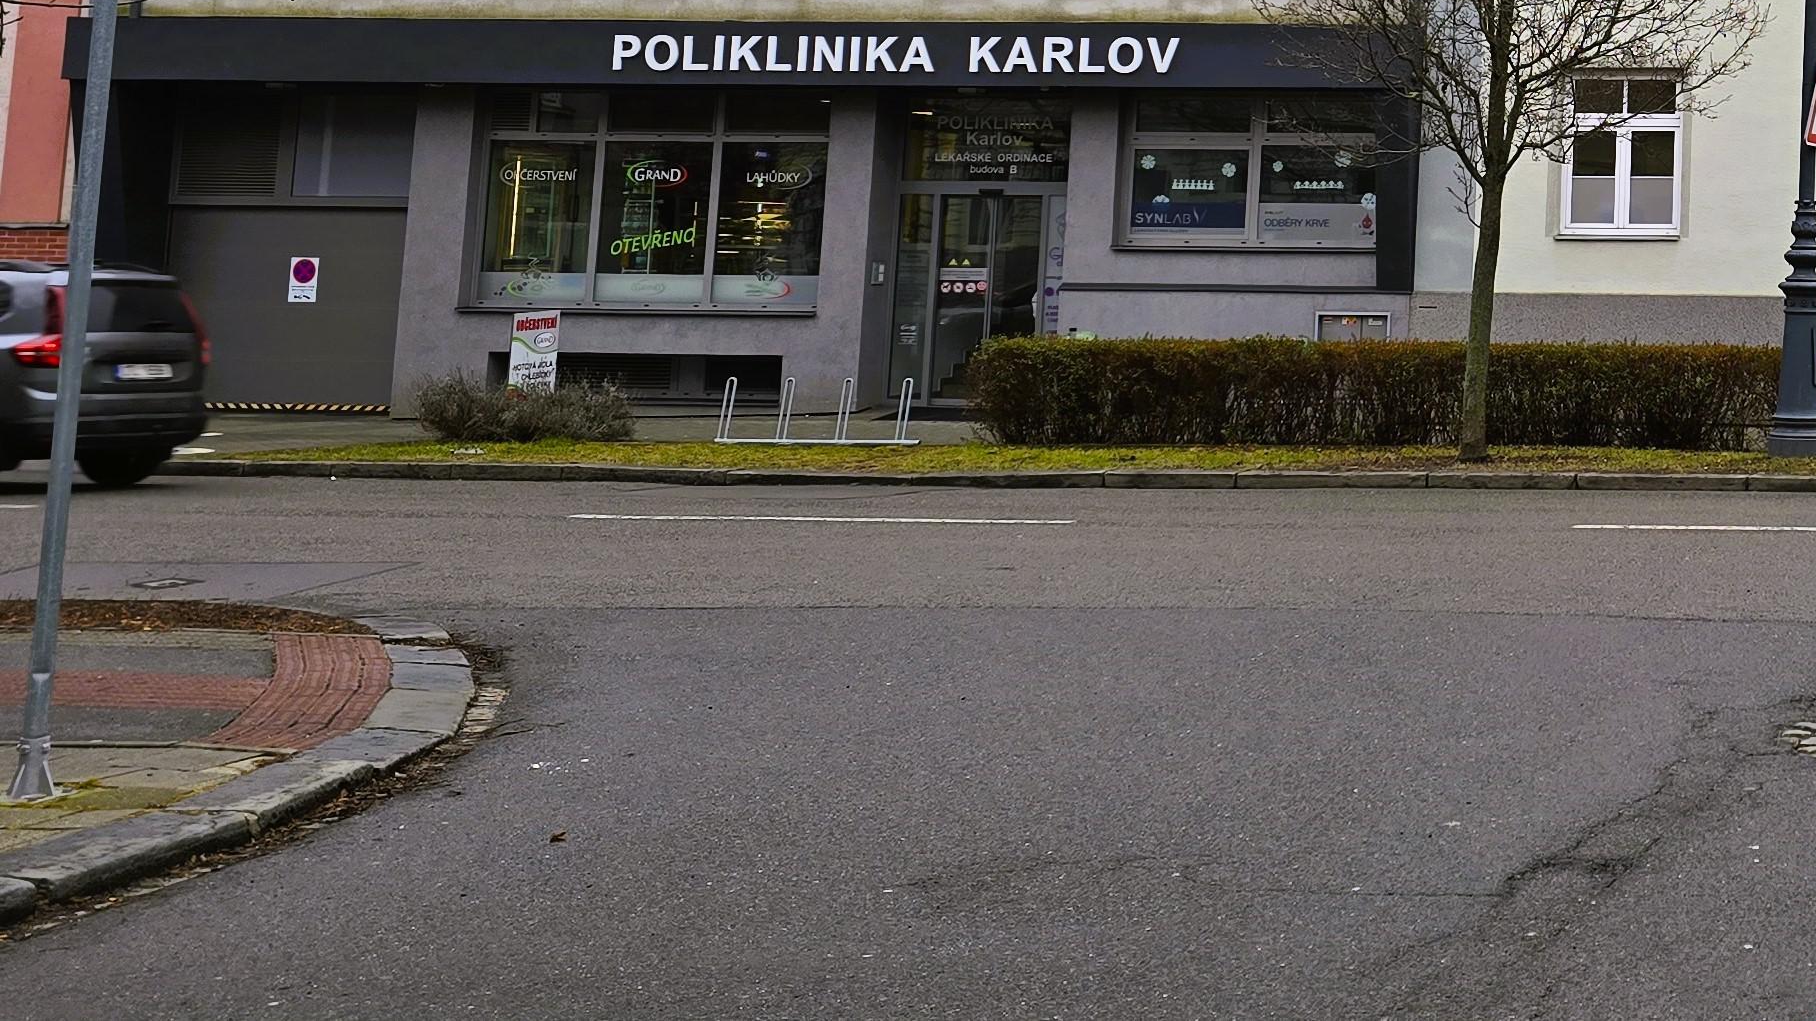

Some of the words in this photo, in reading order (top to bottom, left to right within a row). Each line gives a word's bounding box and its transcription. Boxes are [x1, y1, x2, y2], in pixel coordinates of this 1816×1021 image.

[611, 34, 936, 73] POLIKLINIKA
[967, 35, 1182, 75] KARLOV
[937, 115, 1054, 130] POLIKLINIKA
[966, 131, 1024, 146] Karlov
[997, 152, 1054, 163] ORDINACE
[634, 167, 682, 182] GRAND
[969, 164, 1005, 174] budova
[1009, 164, 1018, 174] B
[1135, 212, 1192, 224] SYNLAB
[1305, 218, 1331, 228] KRVE
[610, 228, 696, 256] OTEVŘENO
